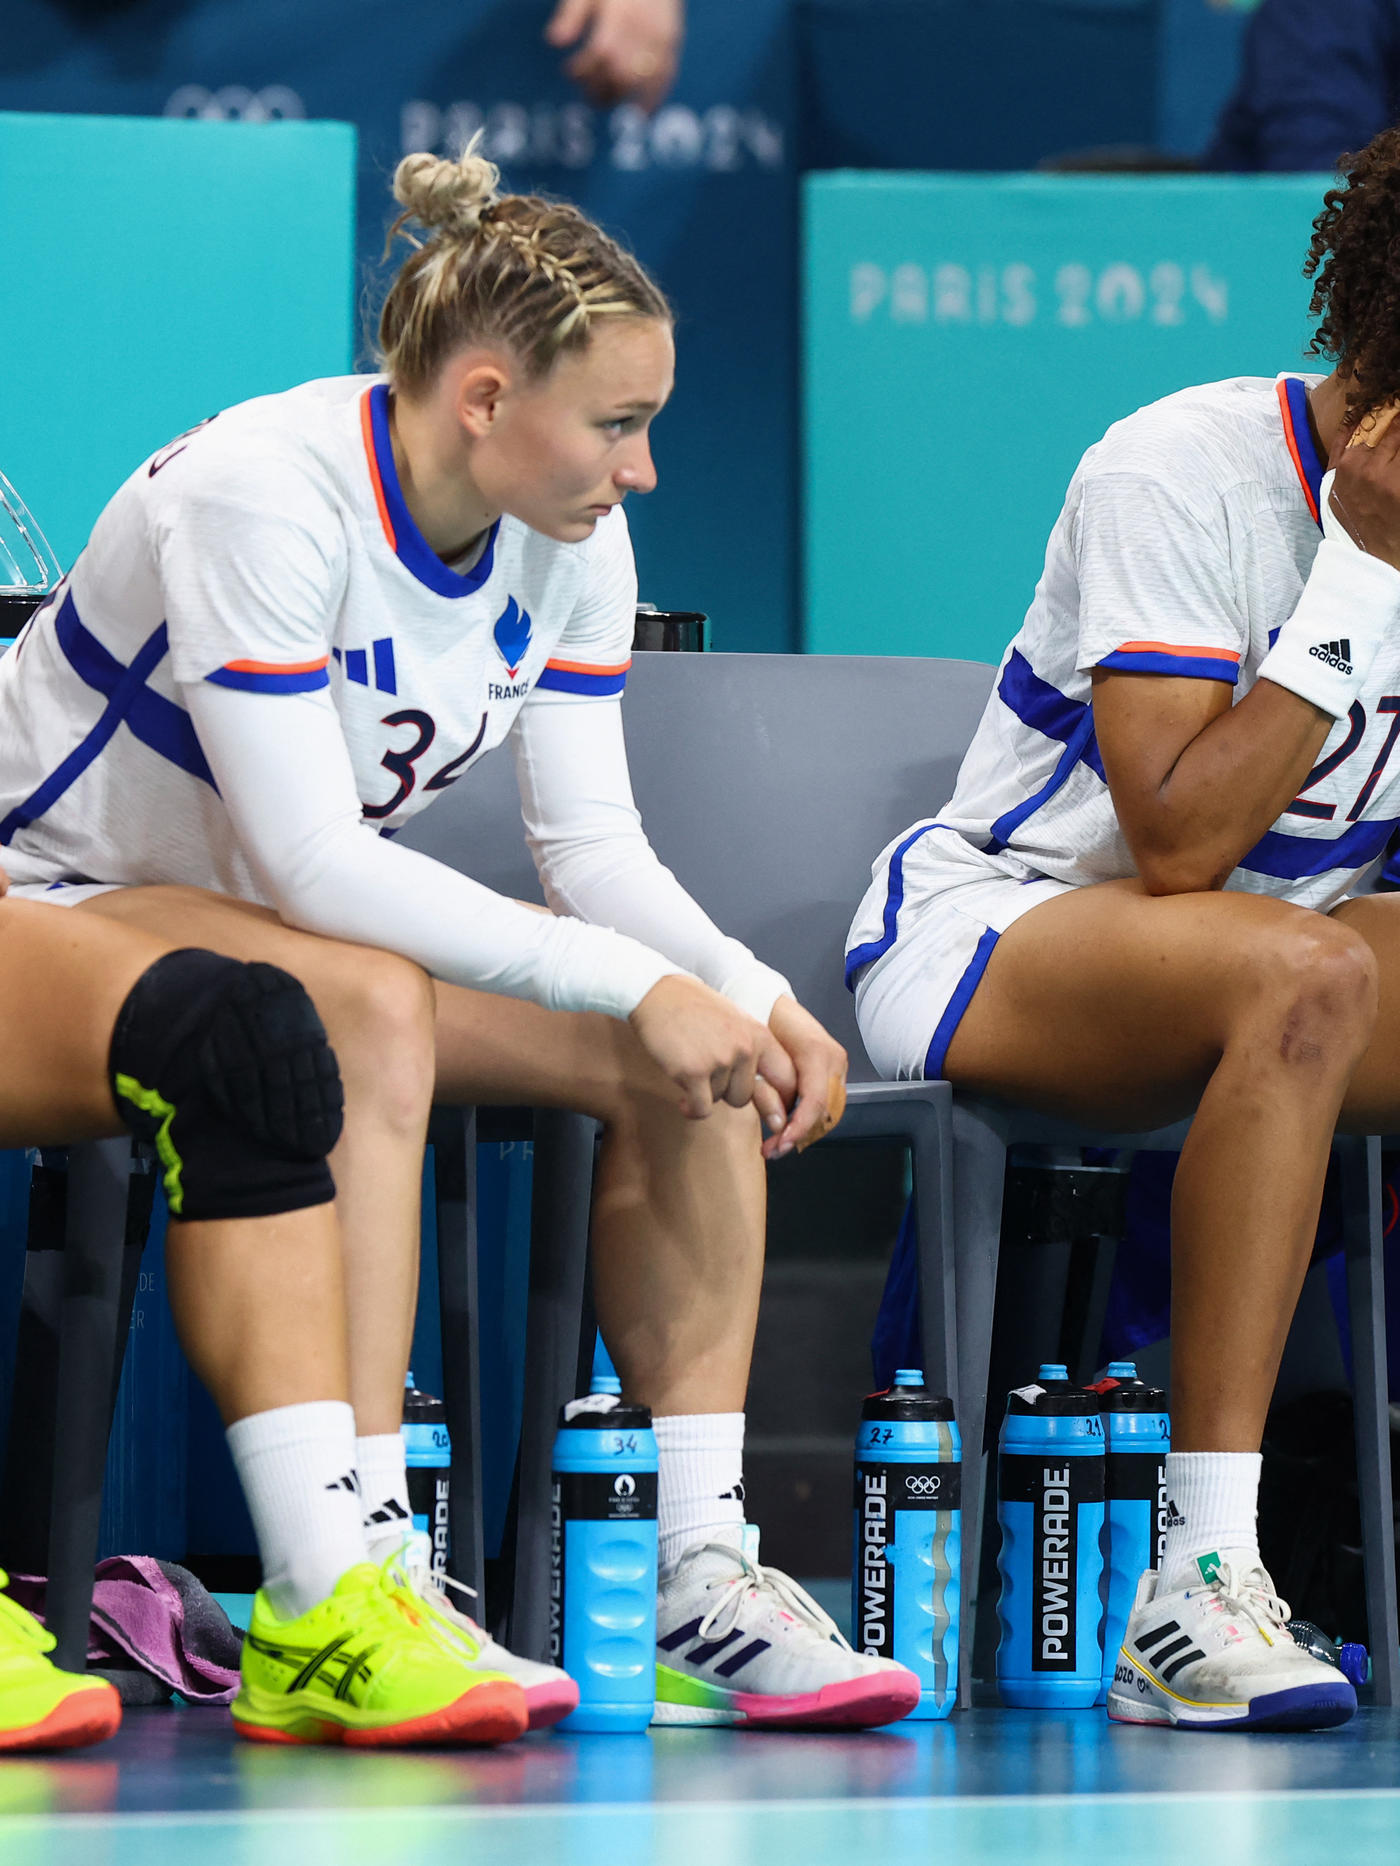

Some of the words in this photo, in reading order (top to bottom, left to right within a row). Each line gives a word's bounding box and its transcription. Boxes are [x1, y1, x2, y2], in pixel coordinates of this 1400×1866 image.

[609, 102, 786, 170] 2024
[849, 261, 1037, 327] PARIS
[1055, 262, 1228, 328] 2024
[1309, 645, 1353, 675] adidas
[614, 1434, 638, 1456] 34
[870, 1427, 894, 1445] 27
[1043, 1468, 1069, 1660] POWERADE
